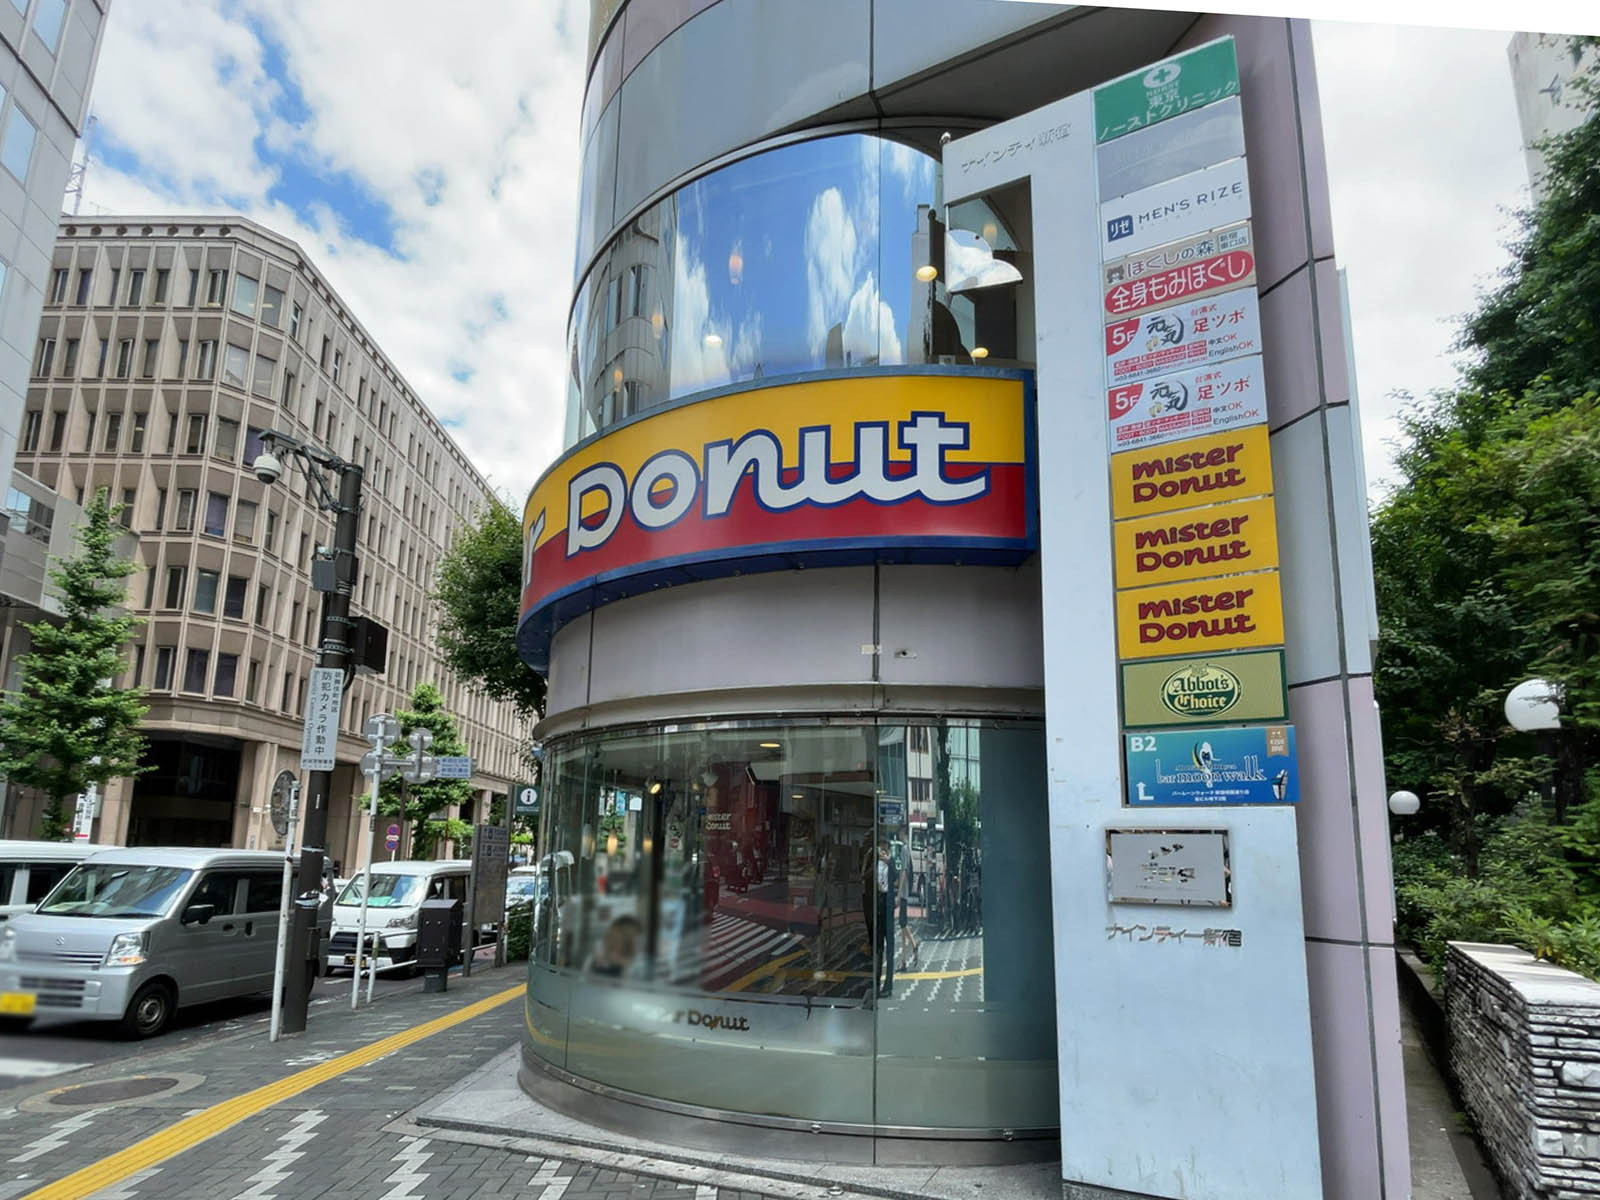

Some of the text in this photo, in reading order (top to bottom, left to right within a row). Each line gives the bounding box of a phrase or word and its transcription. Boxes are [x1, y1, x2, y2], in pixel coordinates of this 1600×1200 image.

[1138, 182, 1243, 224] MEN'S RIZE
[1112, 255, 1246, 313] 全身もみほぐし
[1193, 307, 1246, 334] 足ツボ
[1113, 326, 1135, 346] 5F
[1116, 391, 1139, 410] 5F
[1198, 375, 1251, 400] 足ツボ
[566, 411, 991, 559] Donut
[1133, 468, 1246, 503] Donut
[1136, 540, 1251, 572] Donut
[1139, 614, 1256, 643] Donut
[1173, 674, 1230, 693] Abbot's
[314, 671, 332, 755] 防犯カメラ作動中
[1174, 693, 1227, 710] Choice
[1131, 736, 1157, 752] B2
[688, 1009, 750, 1031] Donut
